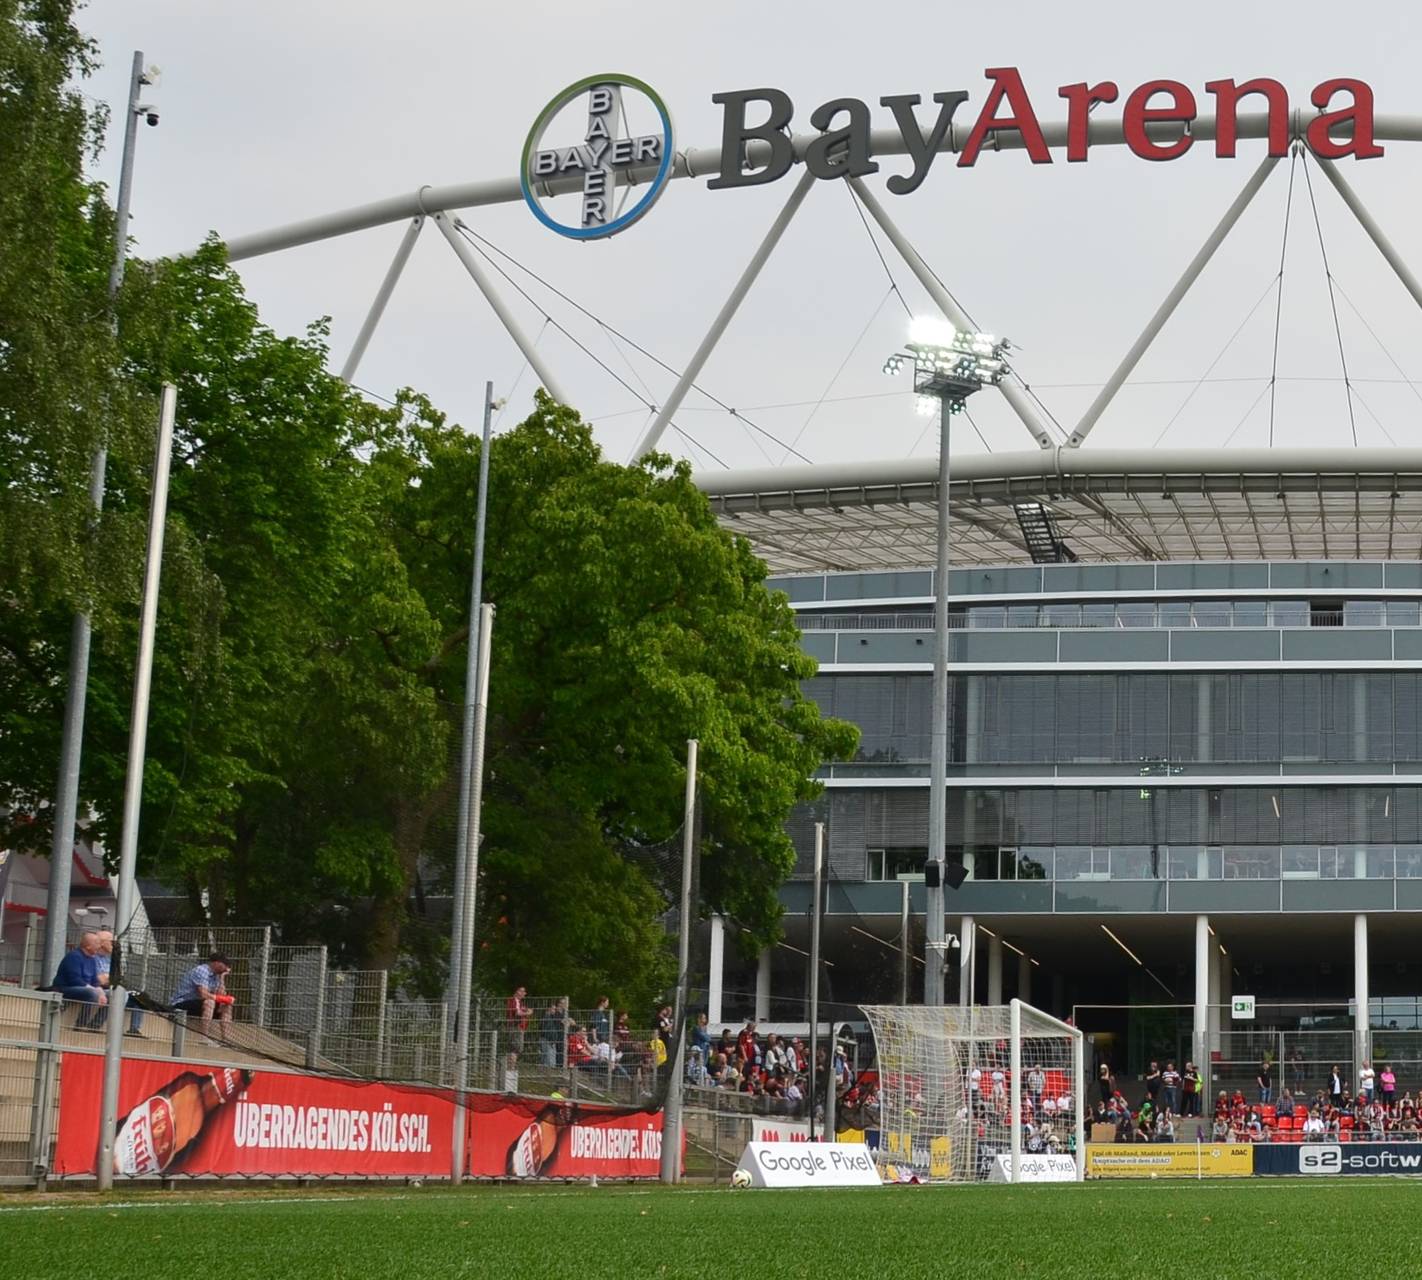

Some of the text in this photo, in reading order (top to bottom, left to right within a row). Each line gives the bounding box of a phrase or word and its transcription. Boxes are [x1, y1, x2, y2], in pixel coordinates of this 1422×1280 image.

[535, 135, 659, 174] BAYER
[582, 88, 612, 223] BAYER
[707, 67, 1385, 195] BayArena
[233, 1091, 431, 1152] ÜBERRAGENDES KÖLSCH.
[759, 1150, 873, 1176] Google Pixel
[1003, 1159, 1045, 1175] Gogle
[1049, 1159, 1075, 1172] Pixel
